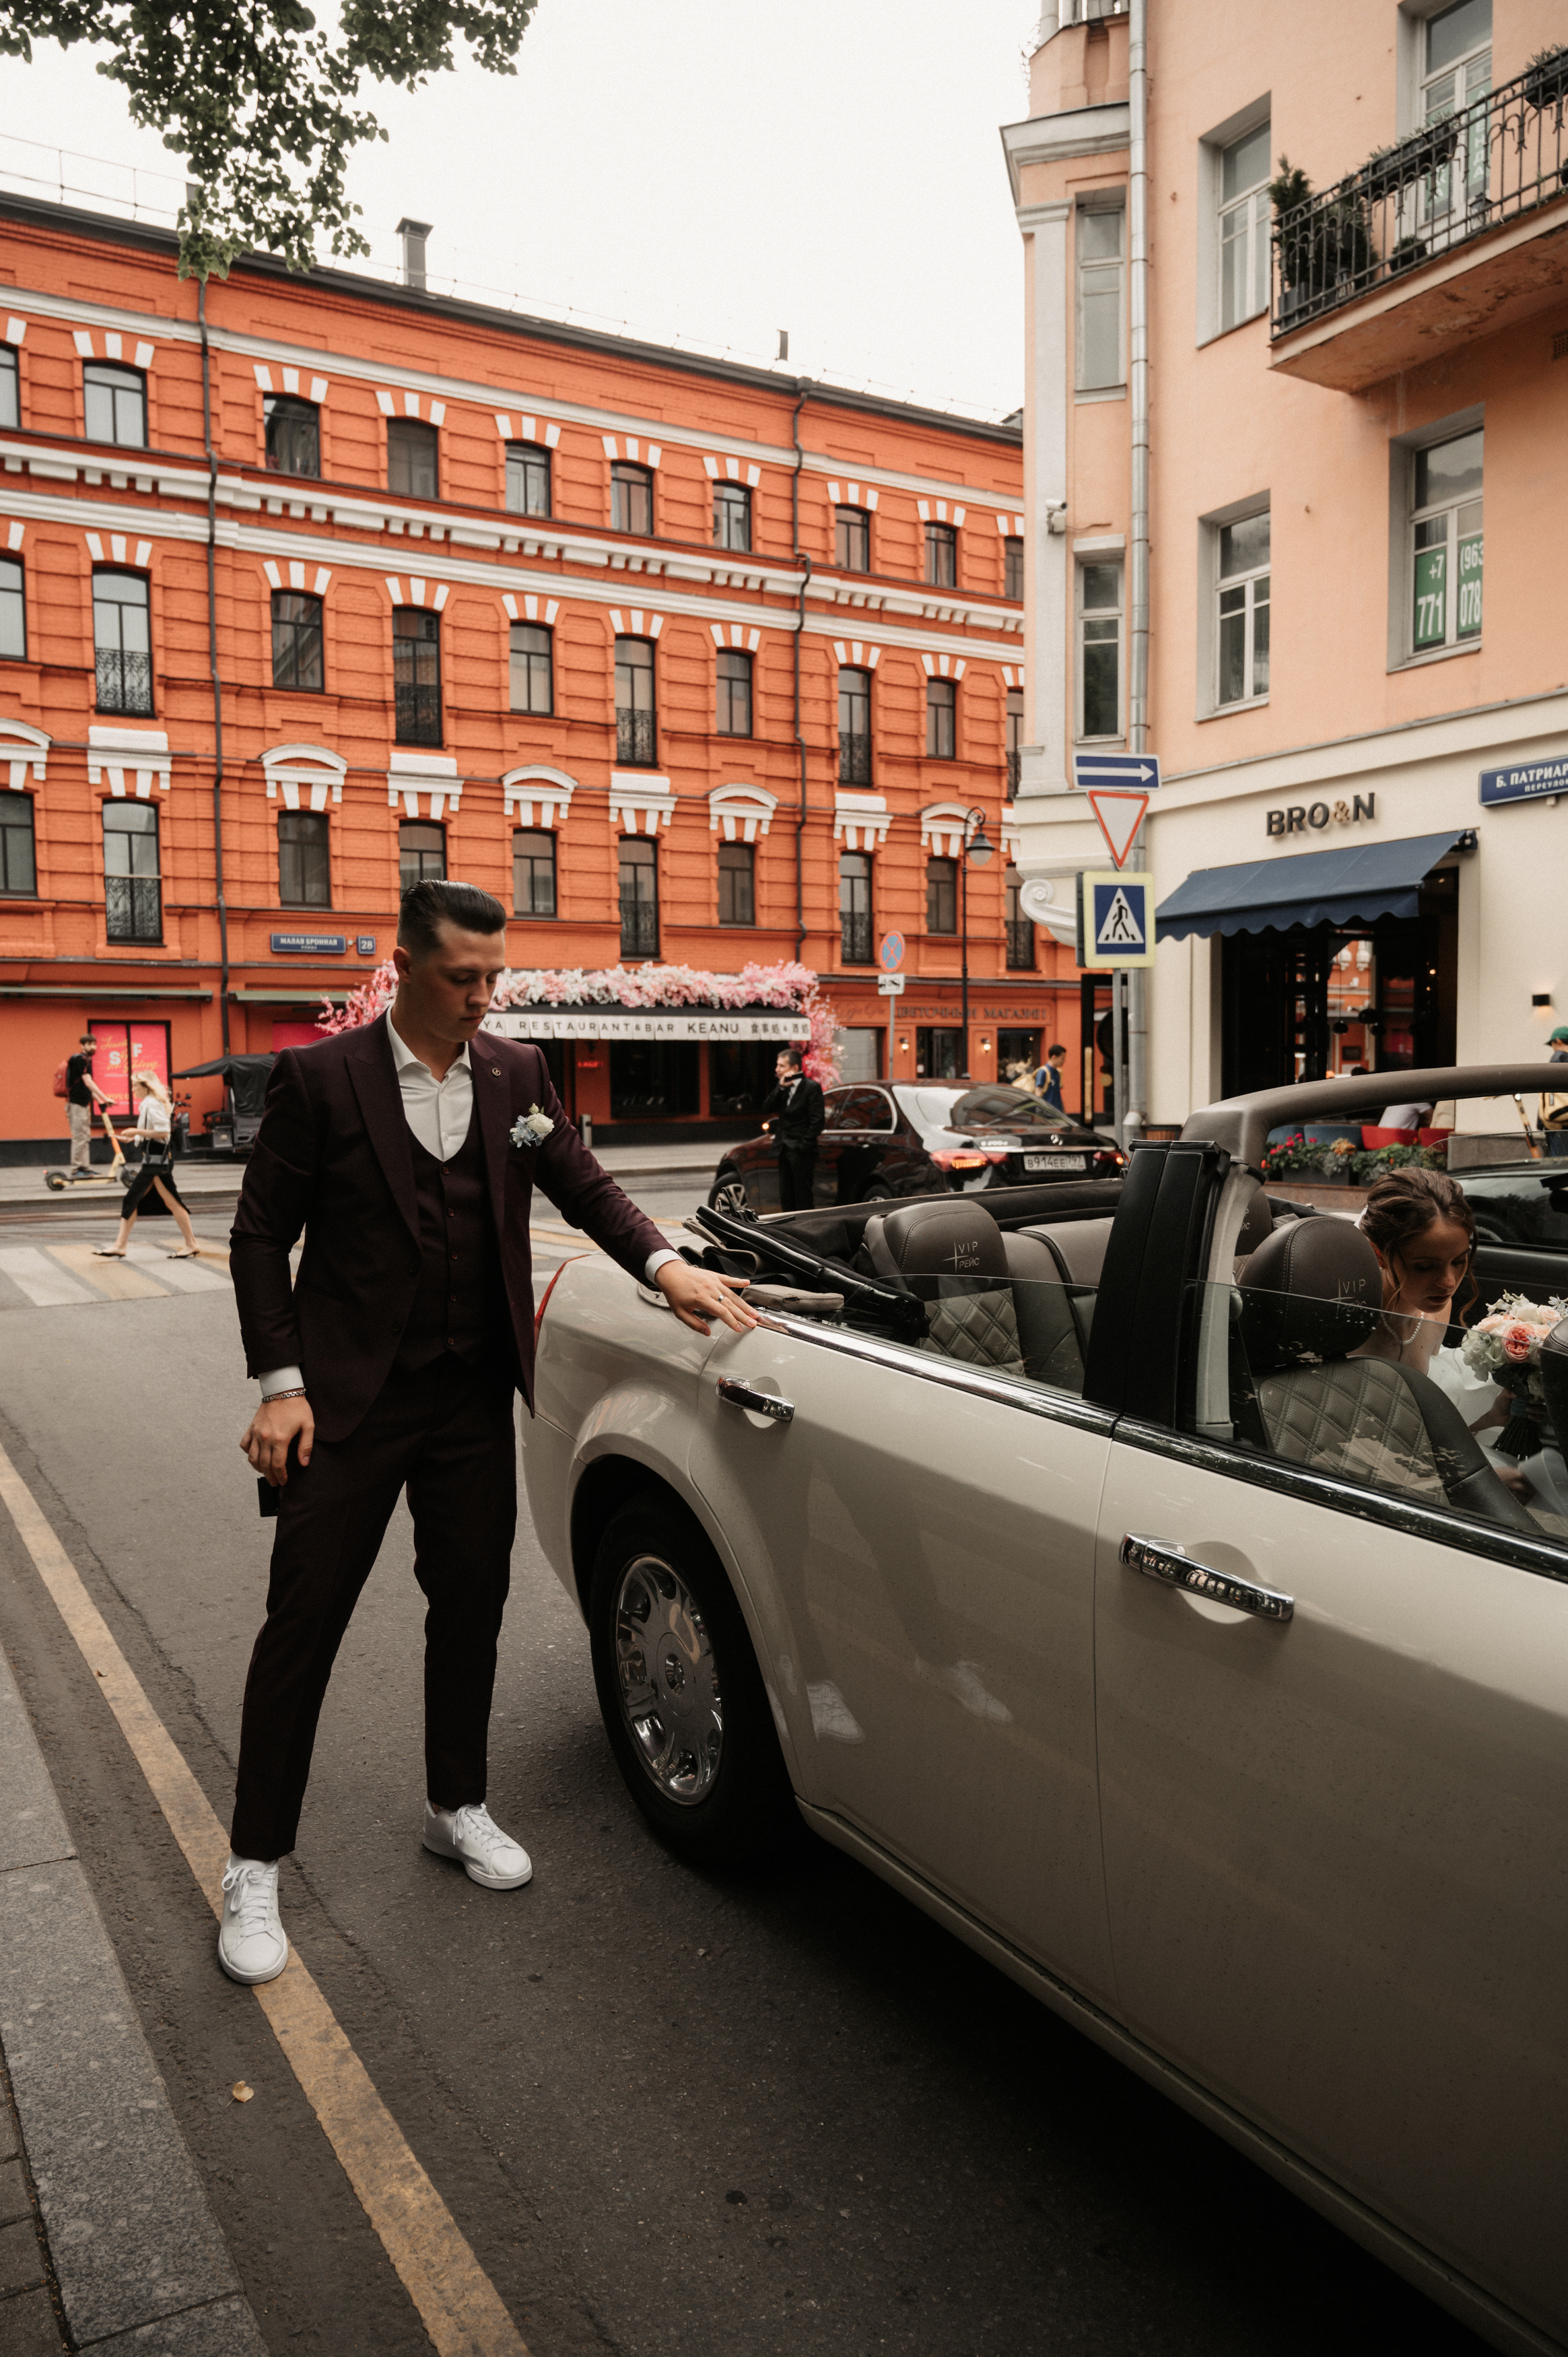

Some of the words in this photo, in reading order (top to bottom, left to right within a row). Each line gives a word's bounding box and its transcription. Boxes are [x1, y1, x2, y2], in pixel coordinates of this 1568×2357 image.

[1429, 554, 1444, 578] +7
[1417, 591, 1443, 638] 771
[1460, 579, 1481, 628] 078
[1495, 775, 1507, 788] Б.
[1266, 792, 1375, 836] BRO&N
[280, 937, 305, 945] МАЛАЯ
[306, 938, 338, 946] БРОННАЯ
[361, 940, 373, 950] 28
[984, 1008, 1046, 1019] МАГАЗИН
[483, 1021, 504, 1030] YA
[687, 1023, 739, 1034] KEANU
[958, 1241, 978, 1254] VIP
[959, 1257, 980, 1269] РЕЙС
[1342, 1279, 1366, 1294] VIP
